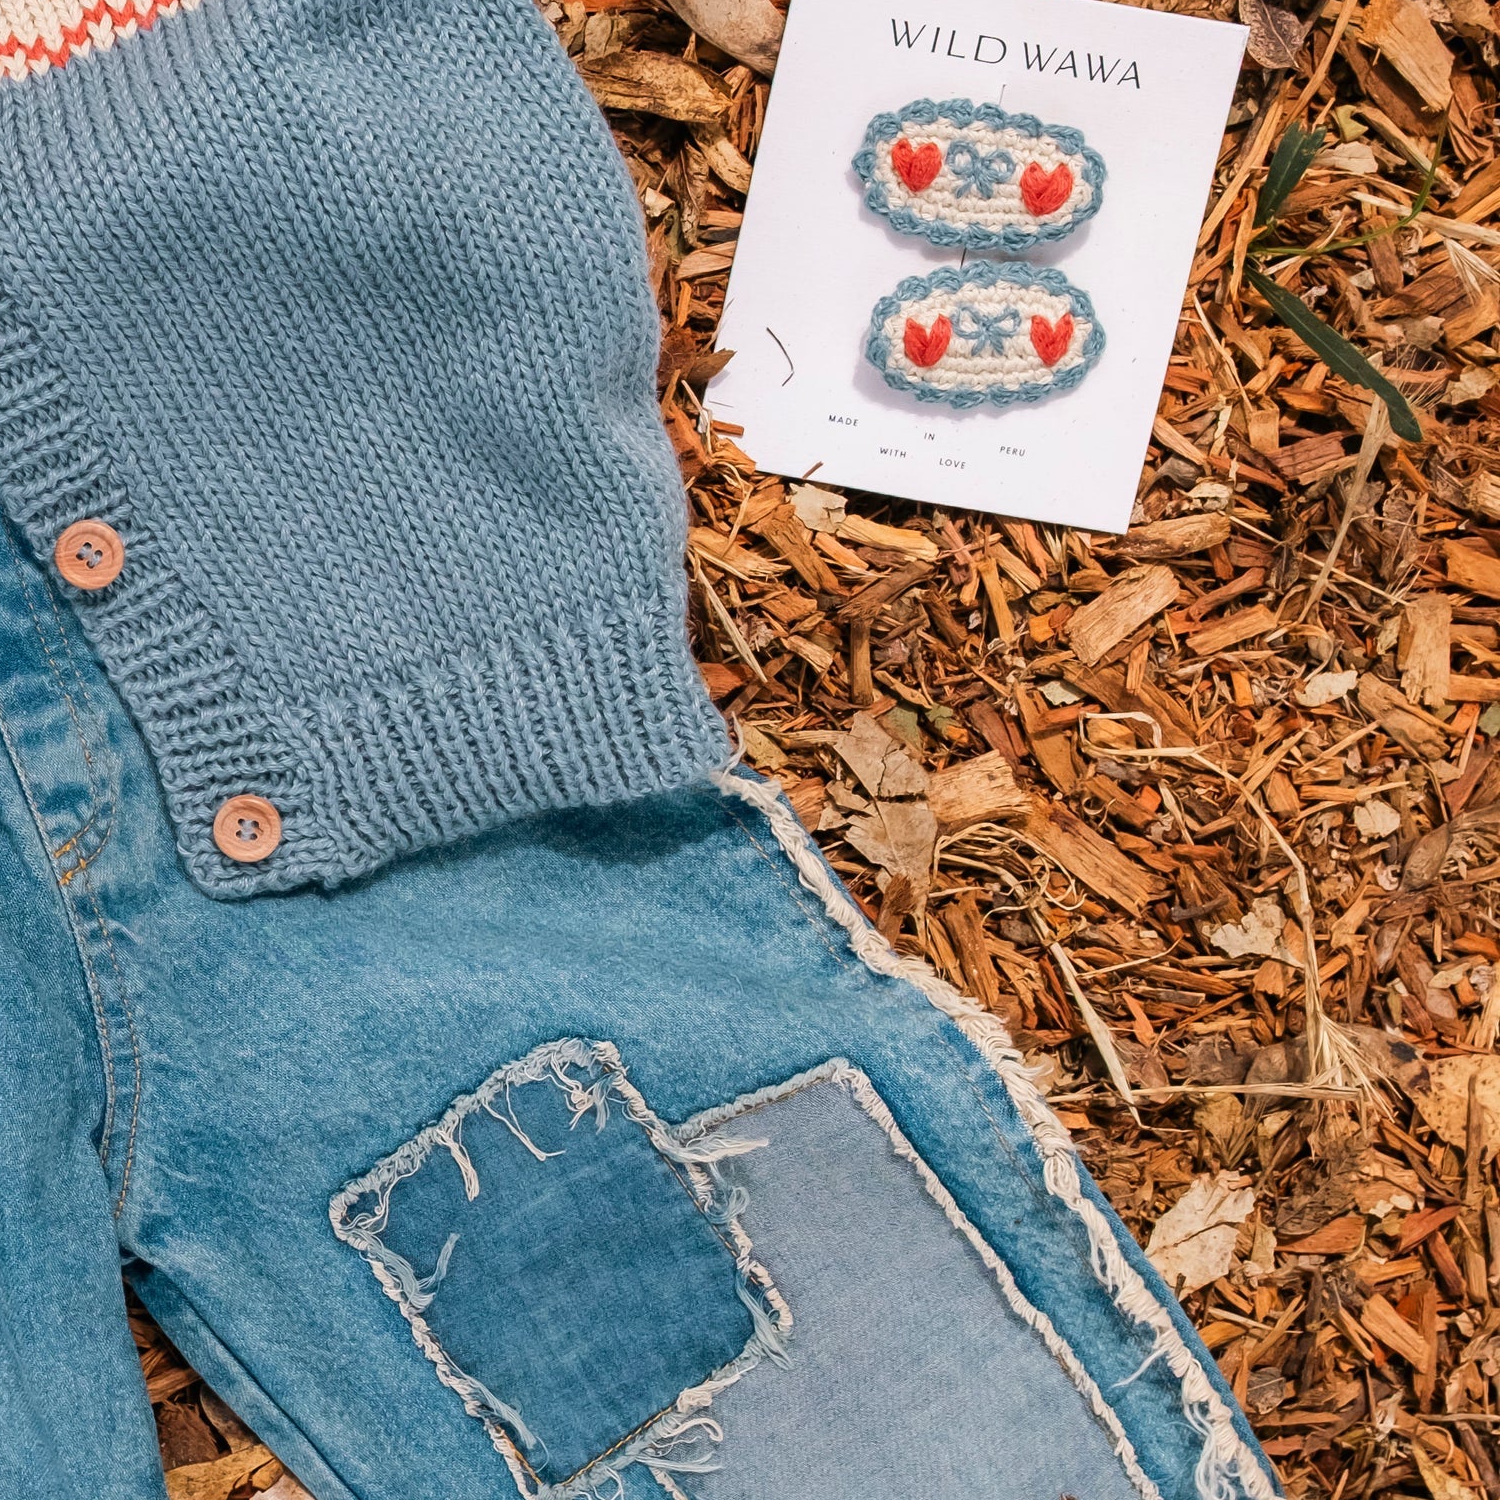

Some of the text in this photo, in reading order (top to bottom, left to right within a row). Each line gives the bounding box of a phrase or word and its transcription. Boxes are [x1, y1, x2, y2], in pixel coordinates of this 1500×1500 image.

[891, 18, 1140, 89] WILD WAWA
[827, 414, 1026, 457] MADE IN PERU
[879, 447, 966, 470] WITH LOVE
